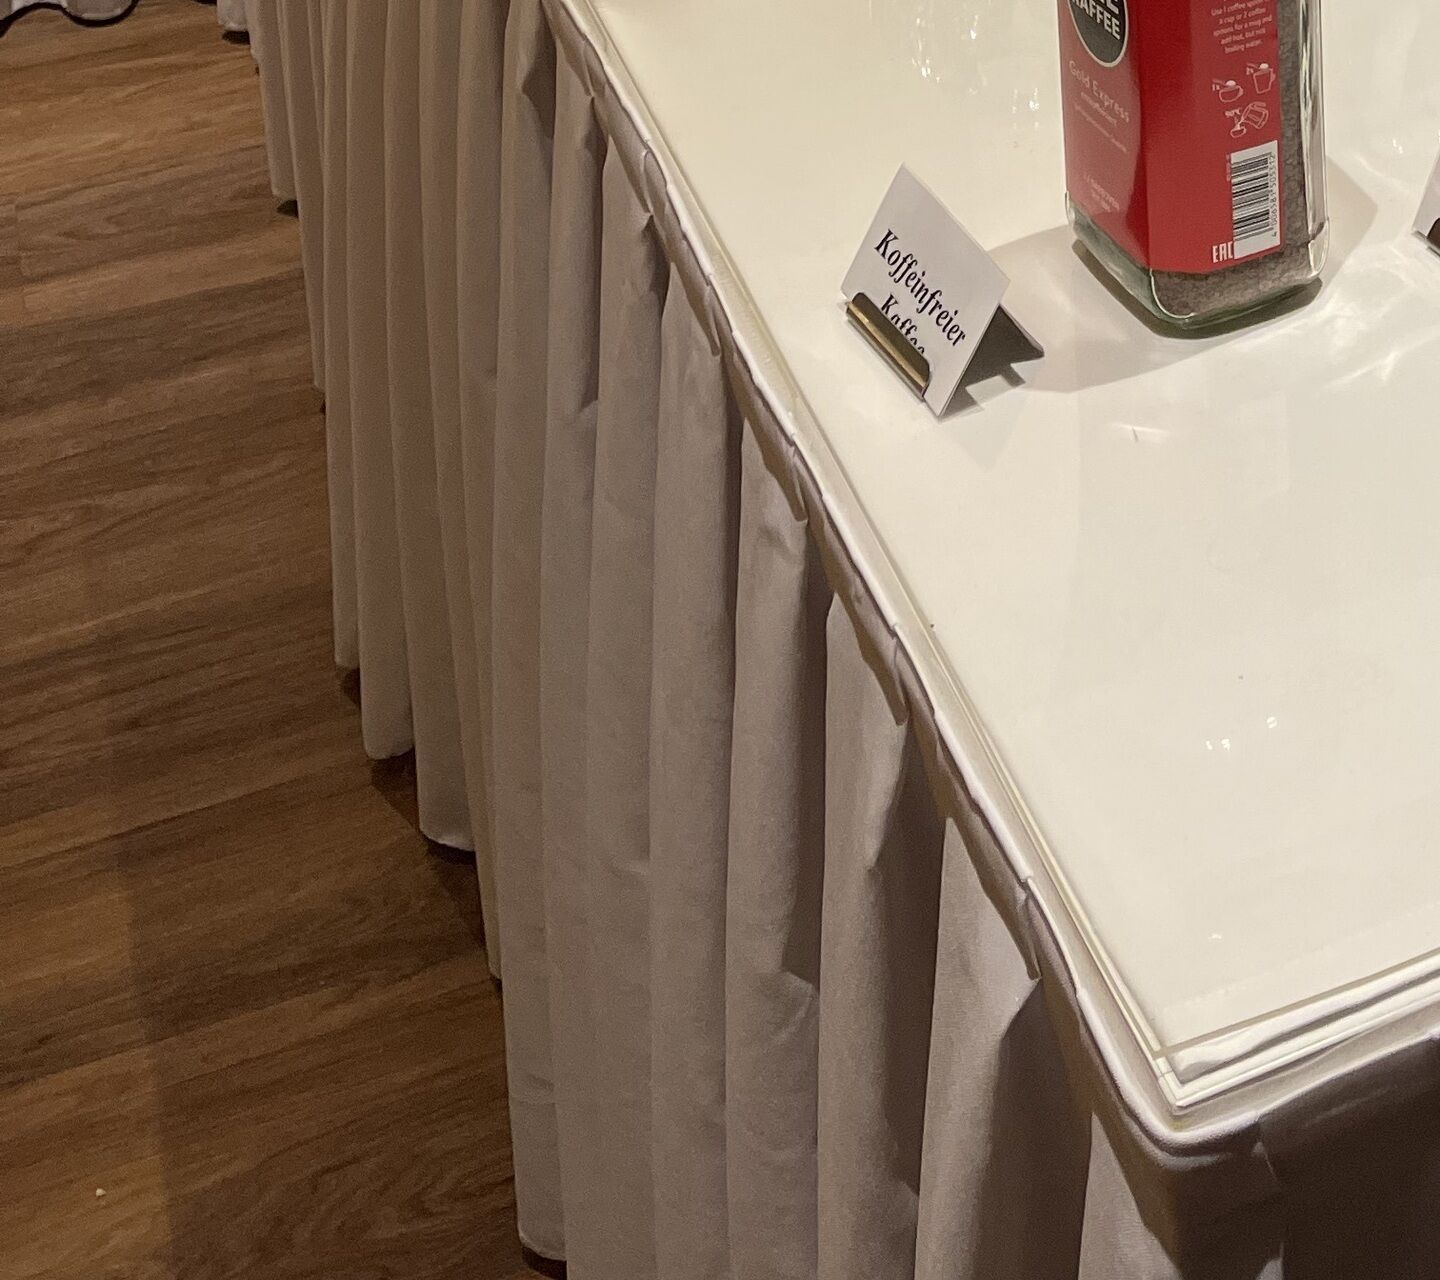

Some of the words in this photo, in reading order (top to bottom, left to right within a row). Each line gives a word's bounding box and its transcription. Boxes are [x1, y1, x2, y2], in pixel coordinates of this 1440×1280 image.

[1069, 60, 1090, 88] Gold
[1092, 79, 1130, 123] Express
[1213, 242, 1234, 264] EAC
[874, 228, 967, 347] Koffeinfreier
